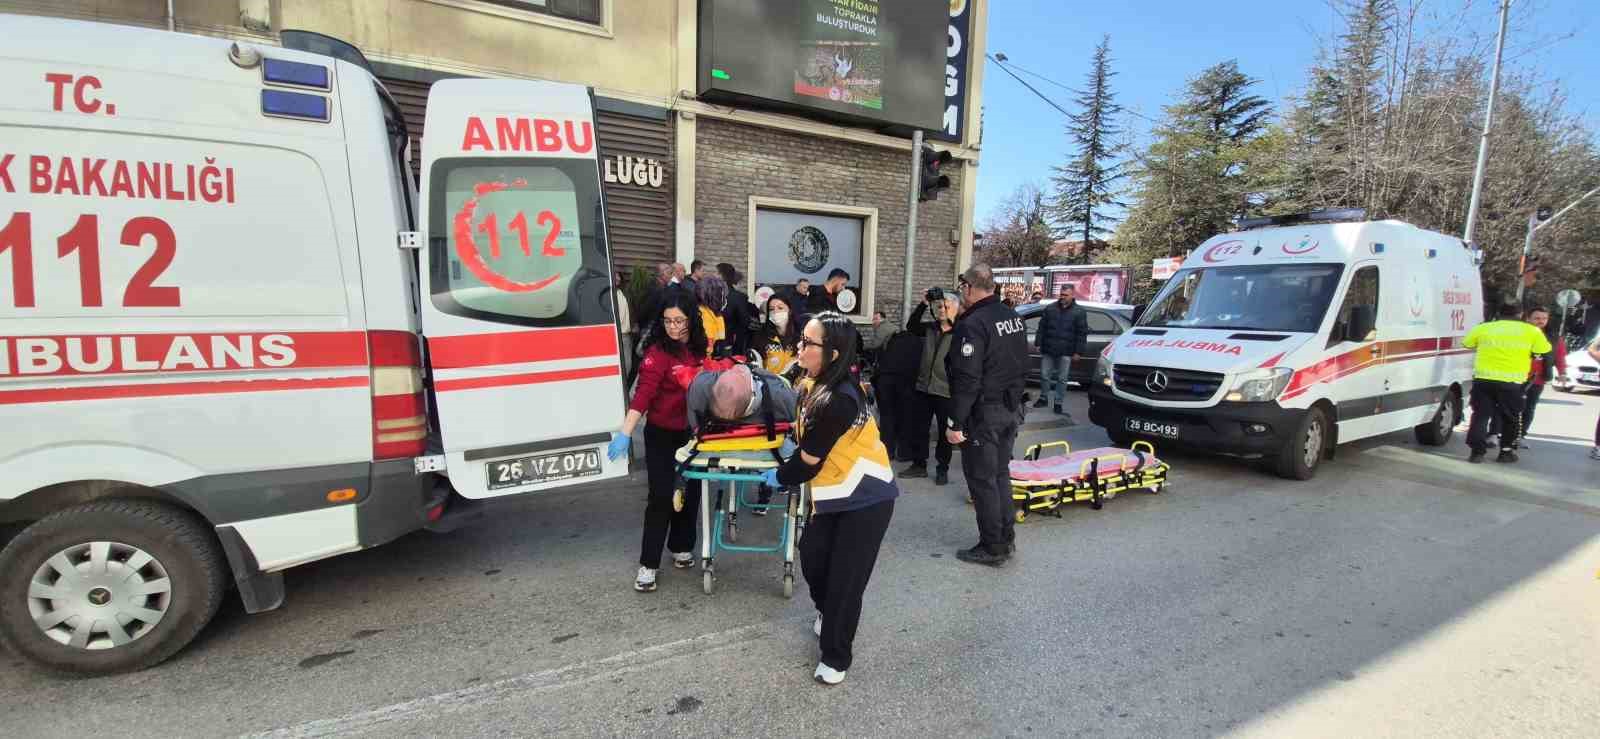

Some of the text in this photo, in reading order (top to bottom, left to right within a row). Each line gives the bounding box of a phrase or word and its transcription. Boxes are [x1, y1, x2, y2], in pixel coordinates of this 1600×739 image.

[834, 7, 877, 25] TOPRAKLA
[46, 73, 116, 115] TC.
[462, 116, 593, 153] AMBU
[30, 154, 235, 204] BAKANLIĞI
[479, 210, 567, 257] 112
[0, 212, 181, 308] 112
[1451, 309, 1465, 331] 112
[497, 462, 523, 482] 26
[531, 457, 560, 476] VZ
